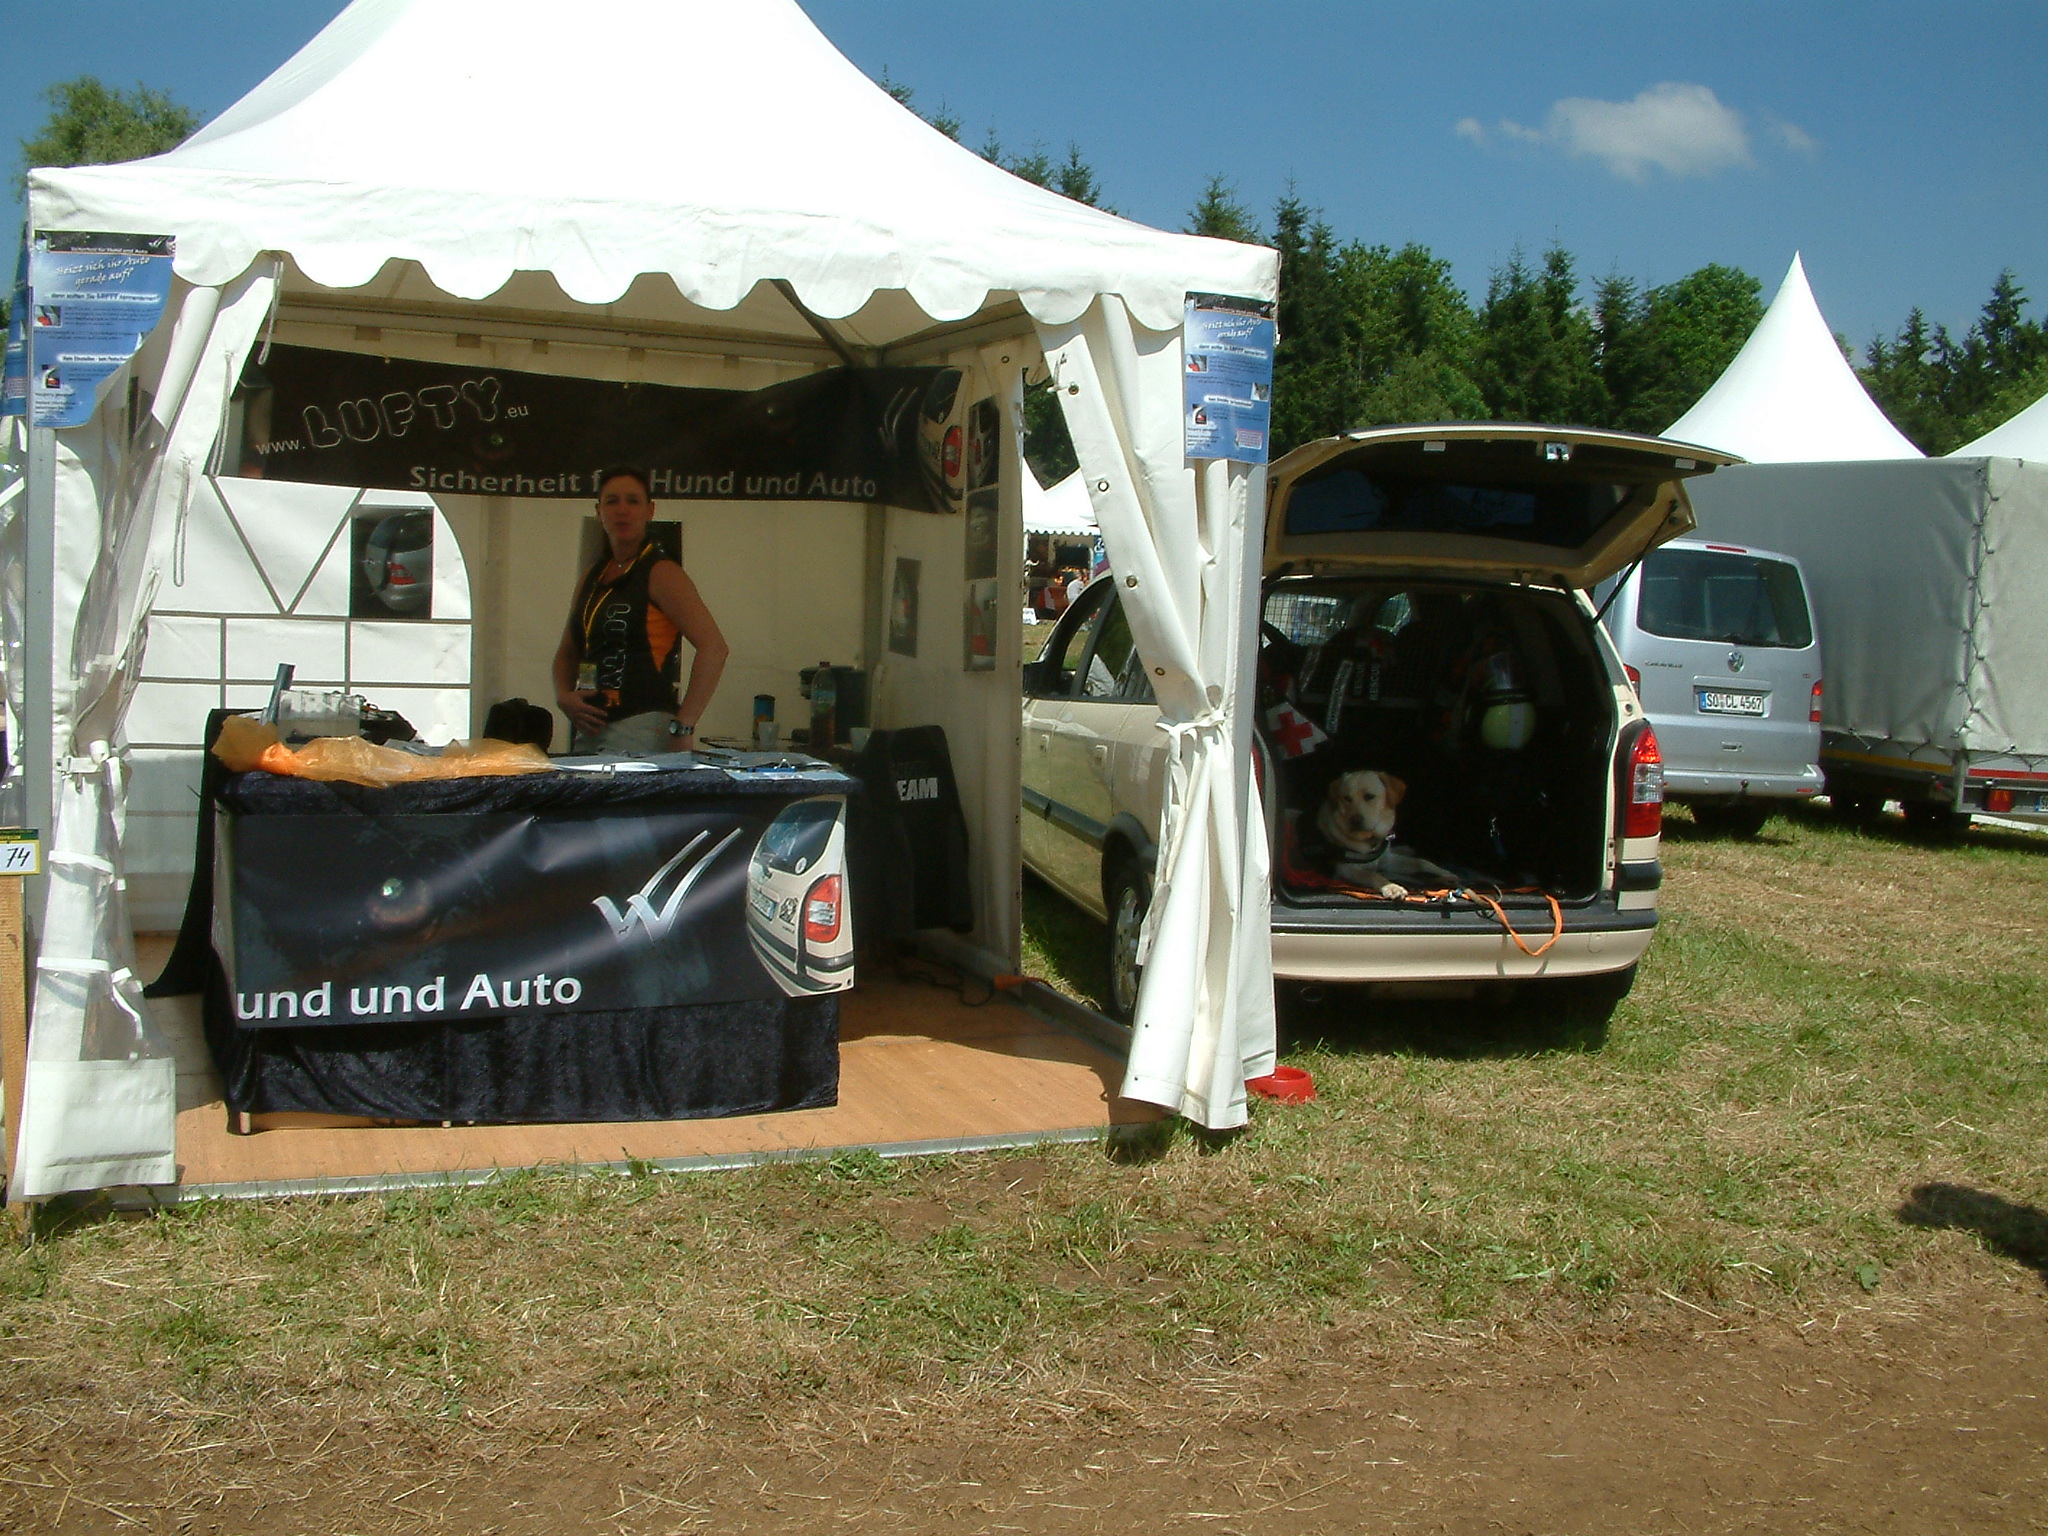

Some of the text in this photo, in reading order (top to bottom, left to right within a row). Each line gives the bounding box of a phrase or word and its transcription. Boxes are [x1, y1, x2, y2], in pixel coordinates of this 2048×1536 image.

[410, 465, 581, 495] Sicherheit
[650, 468, 735, 495] Hund
[745, 470, 803, 496] und
[807, 472, 876, 499] Auto
[1706, 693, 1719, 708] SO
[1725, 694, 1737, 709] CL
[6, 847, 31, 868] 74
[350, 975, 445, 1016] und
[460, 972, 583, 1011] Auto
